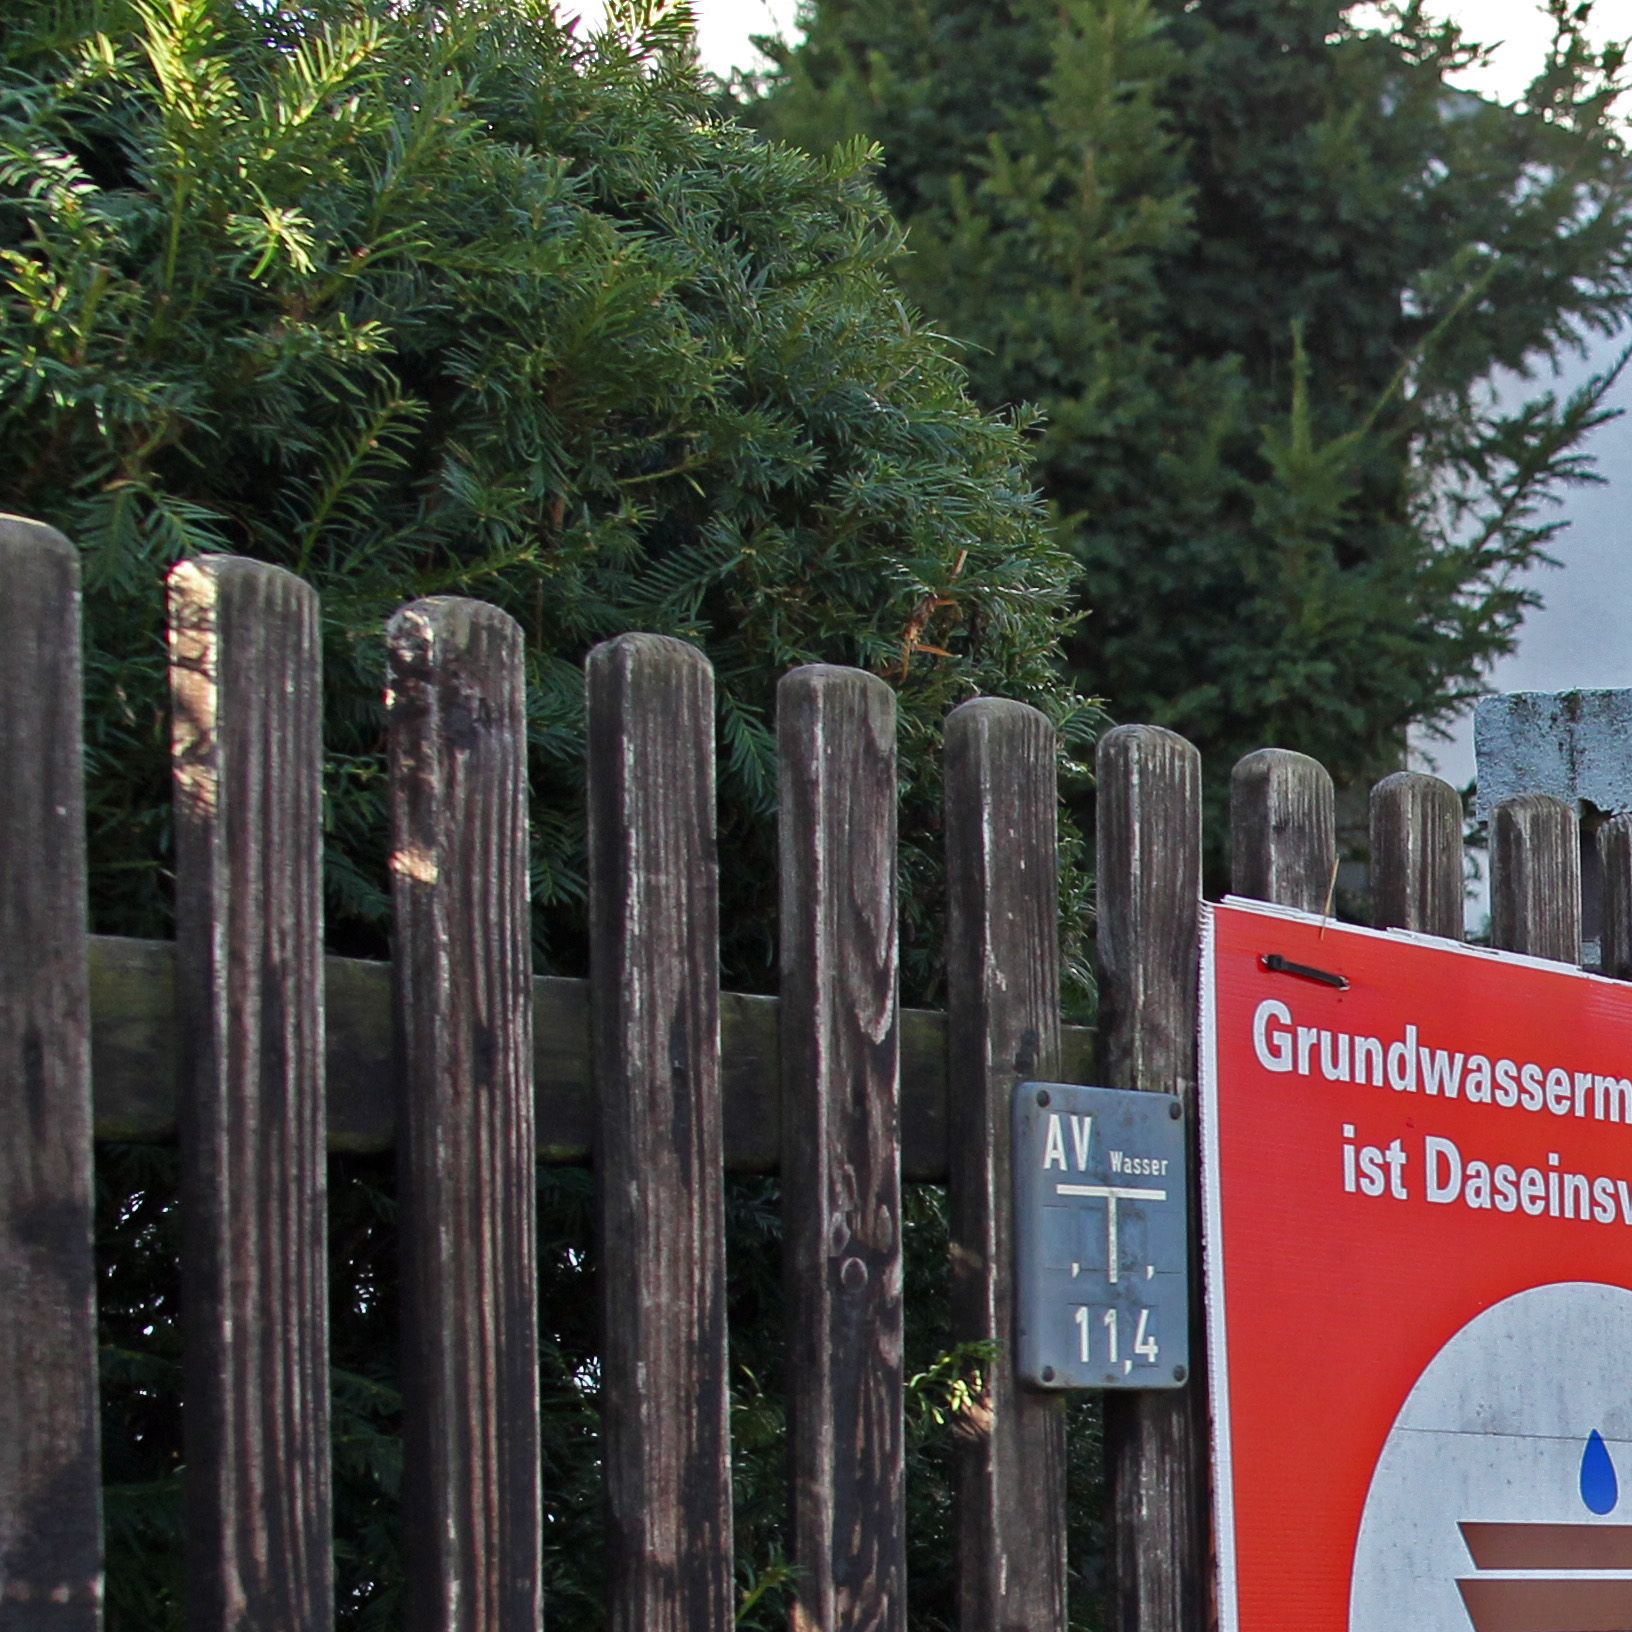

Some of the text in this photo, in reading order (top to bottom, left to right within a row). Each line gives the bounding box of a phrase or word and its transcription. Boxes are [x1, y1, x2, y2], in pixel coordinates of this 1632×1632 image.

[1042, 1113, 1092, 1171] AV
[1109, 1151, 1169, 1176] Wasser
[1343, 1123, 1408, 1200] ist
[1075, 1306, 1159, 1375] 11,4
